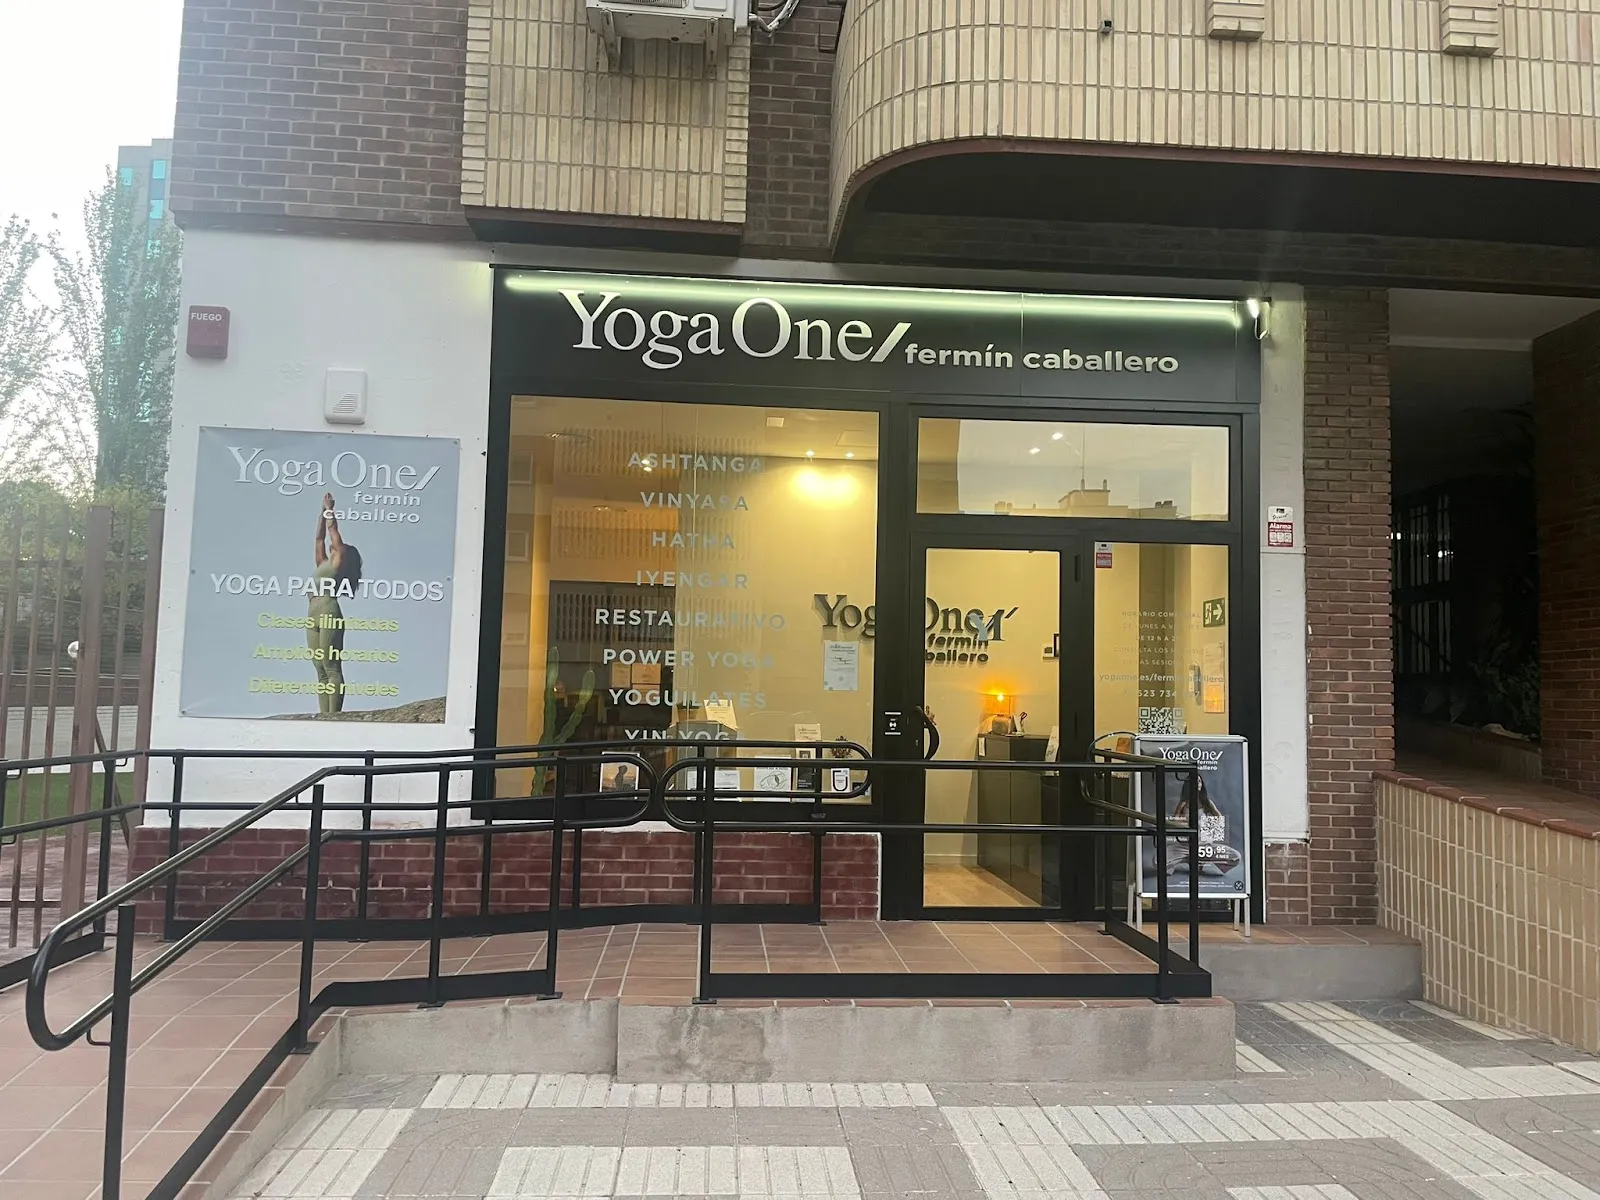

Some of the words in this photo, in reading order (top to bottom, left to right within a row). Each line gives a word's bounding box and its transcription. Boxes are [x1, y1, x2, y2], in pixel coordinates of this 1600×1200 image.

[190, 312, 222, 322] FUEGO
[904, 343, 1013, 369] fermín
[1022, 349, 1179, 374] caballero
[627, 452, 764, 473] ASHTANGA
[353, 491, 421, 506] fermín
[322, 508, 420, 523] caballero
[652, 531, 734, 549] HATHA
[211, 573, 282, 596] YOGA
[288, 576, 354, 598] PARA
[358, 579, 445, 601] TODOS
[636, 570, 748, 589] IYENGAR
[257, 612, 315, 629] Clases
[319, 613, 400, 631] ilimitadas
[595, 608, 786, 631] RESTAURATIVO
[813, 593, 876, 639] Yog
[253, 643, 325, 663] Amplios
[329, 646, 400, 662] horarios
[603, 648, 695, 667] POWER
[707, 652, 775, 668] YOGA
[925, 649, 989, 663] ballero
[249, 677, 335, 695] Diferentes
[339, 681, 400, 697] niveles
[609, 688, 767, 709] YOGUILATES
[679, 730, 745, 741] YOG
